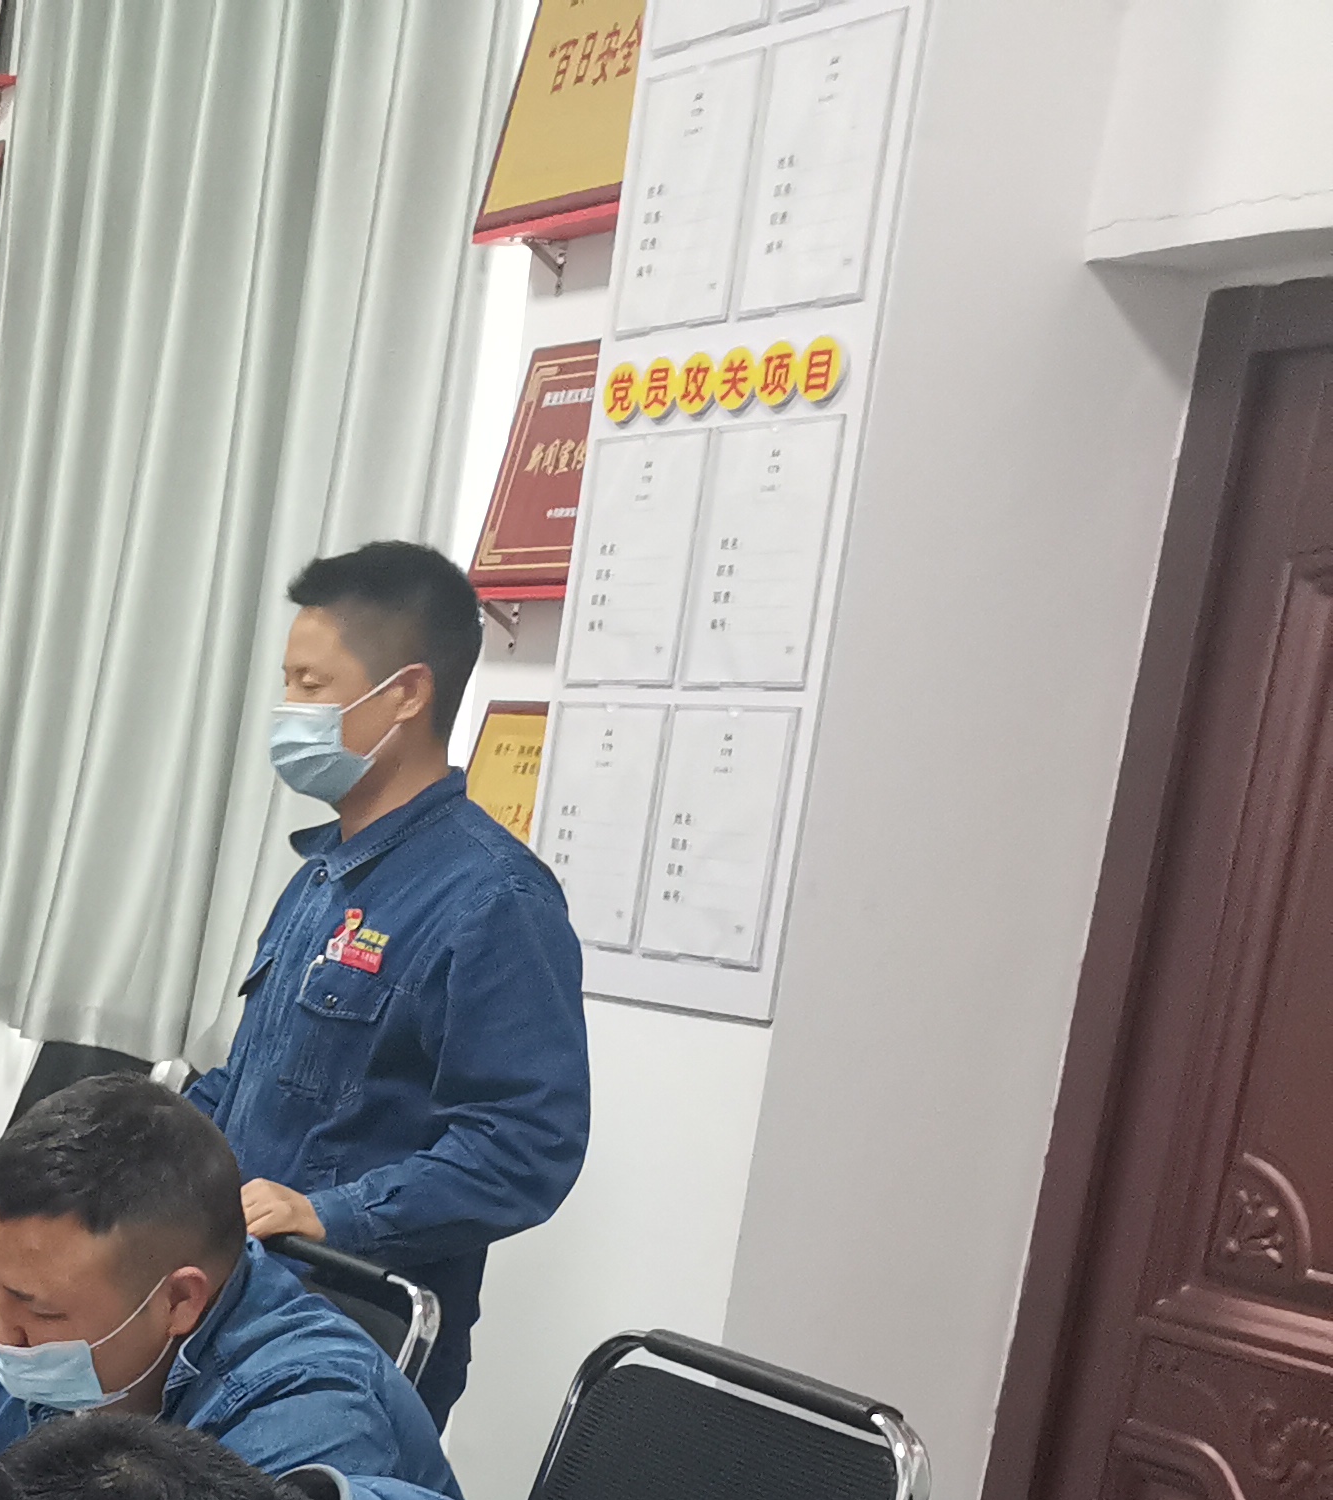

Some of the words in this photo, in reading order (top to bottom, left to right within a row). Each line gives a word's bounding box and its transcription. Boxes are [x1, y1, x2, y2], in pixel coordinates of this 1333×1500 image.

[608, 349, 833, 415] 党员攻关项目
